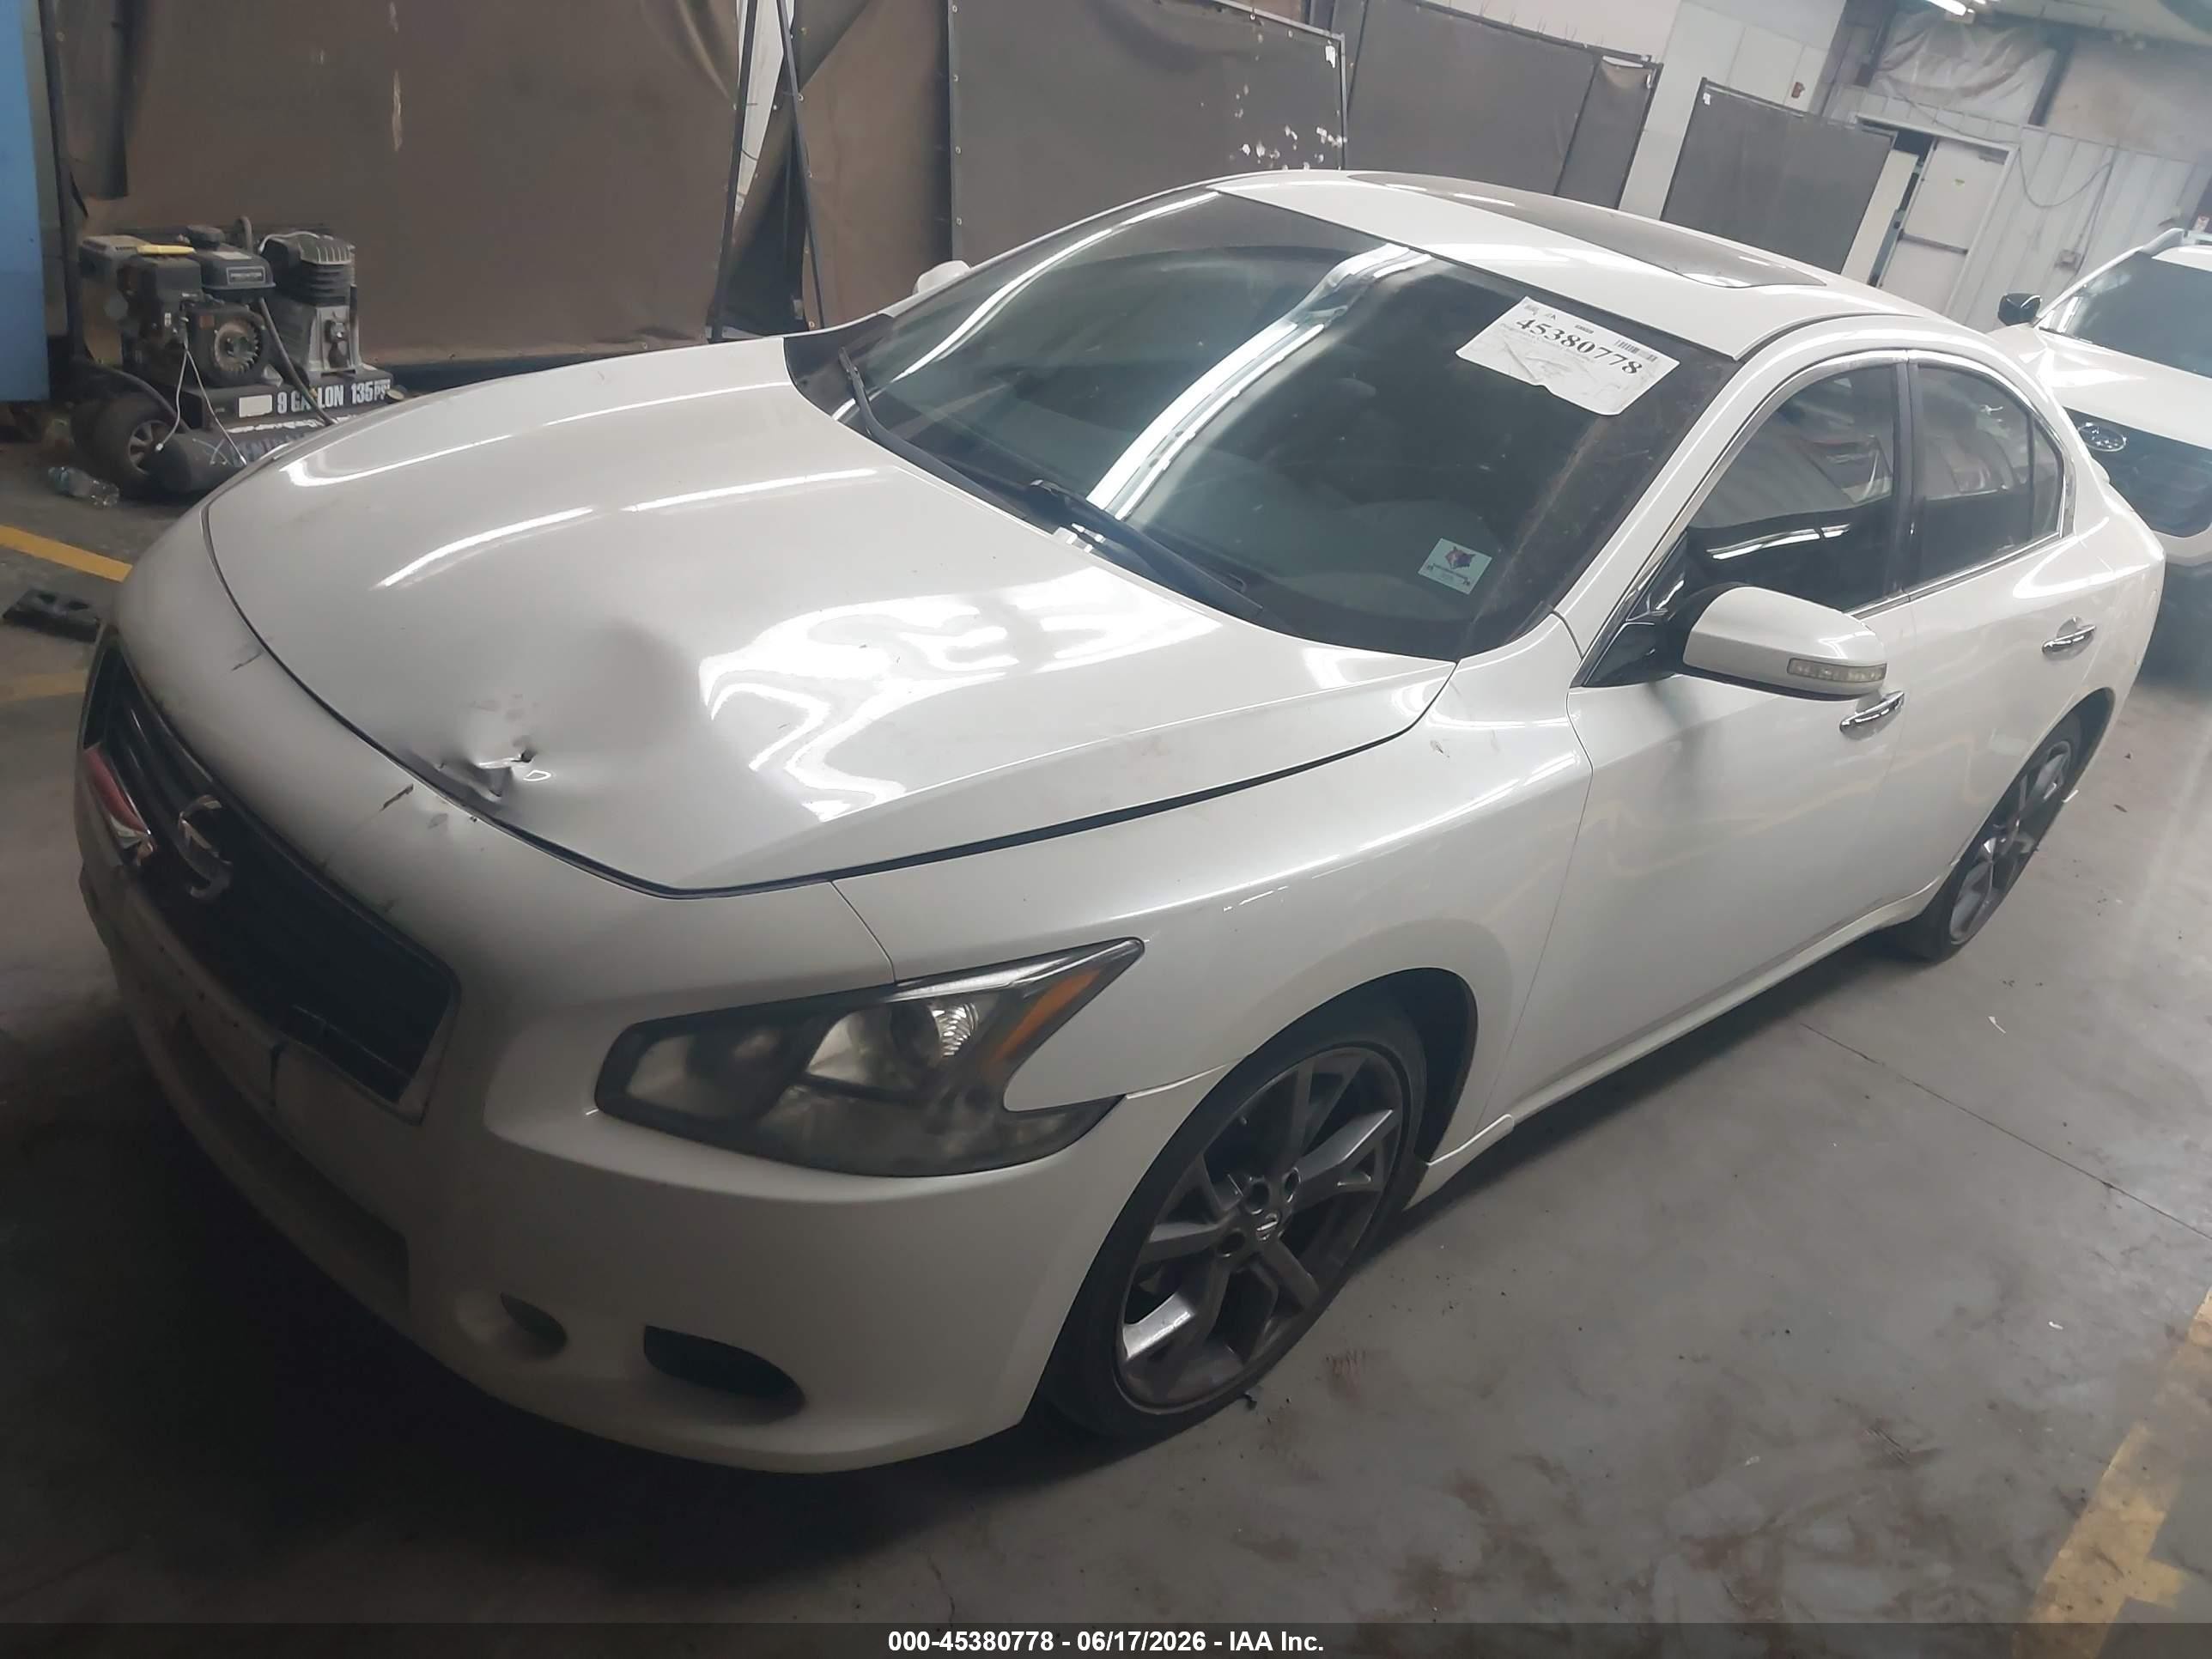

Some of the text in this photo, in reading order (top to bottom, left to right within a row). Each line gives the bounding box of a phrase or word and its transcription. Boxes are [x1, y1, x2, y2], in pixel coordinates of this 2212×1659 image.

[1516, 319, 1643, 374] 45380778
[276, 391, 288, 414] 9
[290, 384, 344, 412] GALON
[350, 380, 374, 404] 135
